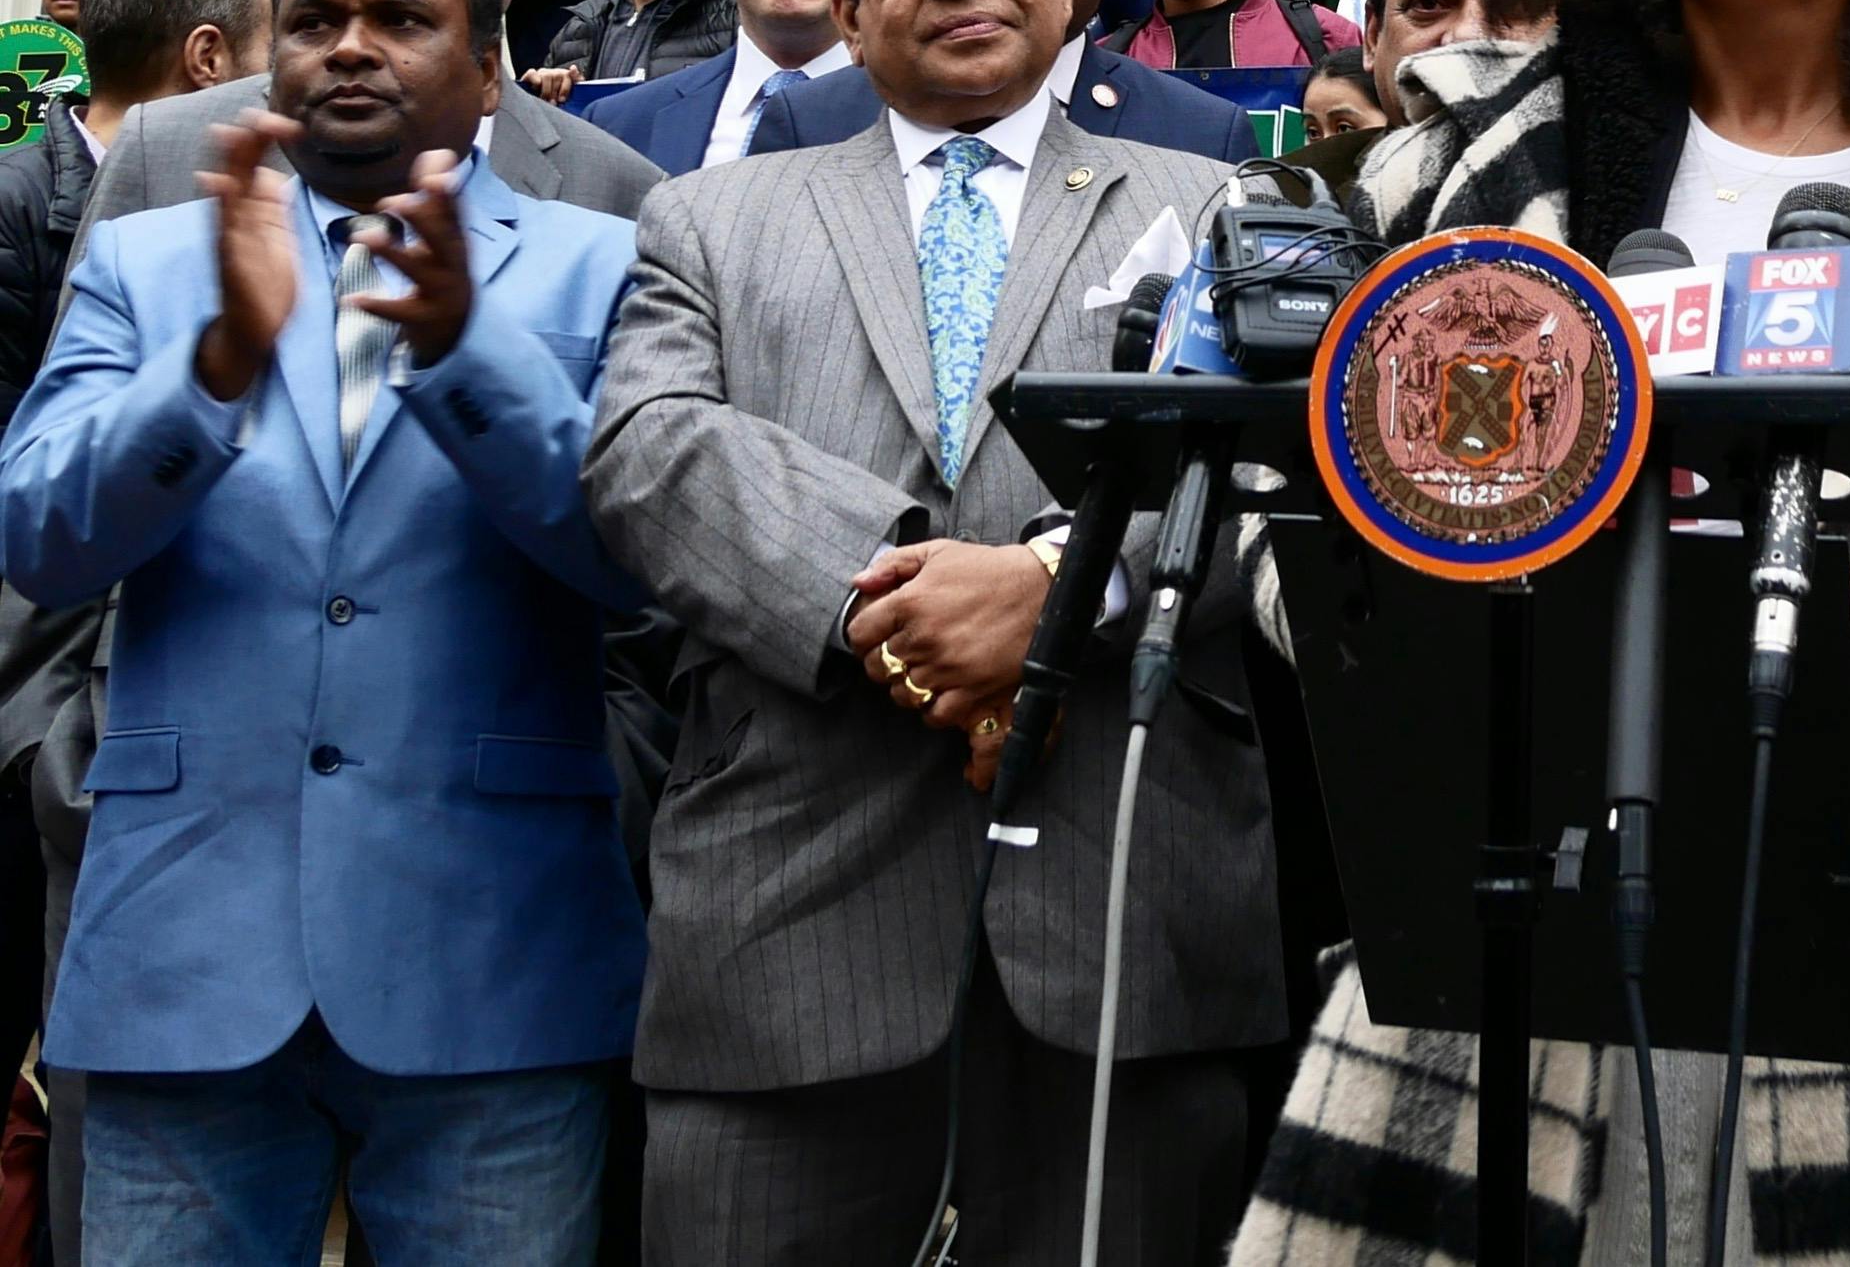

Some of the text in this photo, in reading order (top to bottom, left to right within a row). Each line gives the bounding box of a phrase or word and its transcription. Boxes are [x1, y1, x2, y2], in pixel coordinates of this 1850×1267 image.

[10, 23, 56, 39] MAKES
[58, 32, 83, 56] THIS
[1761, 256, 1831, 287] FOX
[1279, 298, 1329, 313] SONY
[1764, 291, 1818, 347] 5
[1189, 320, 1221, 342] NE
[1746, 349, 1826, 367] NEWS
[1449, 484, 1504, 506] 1625
